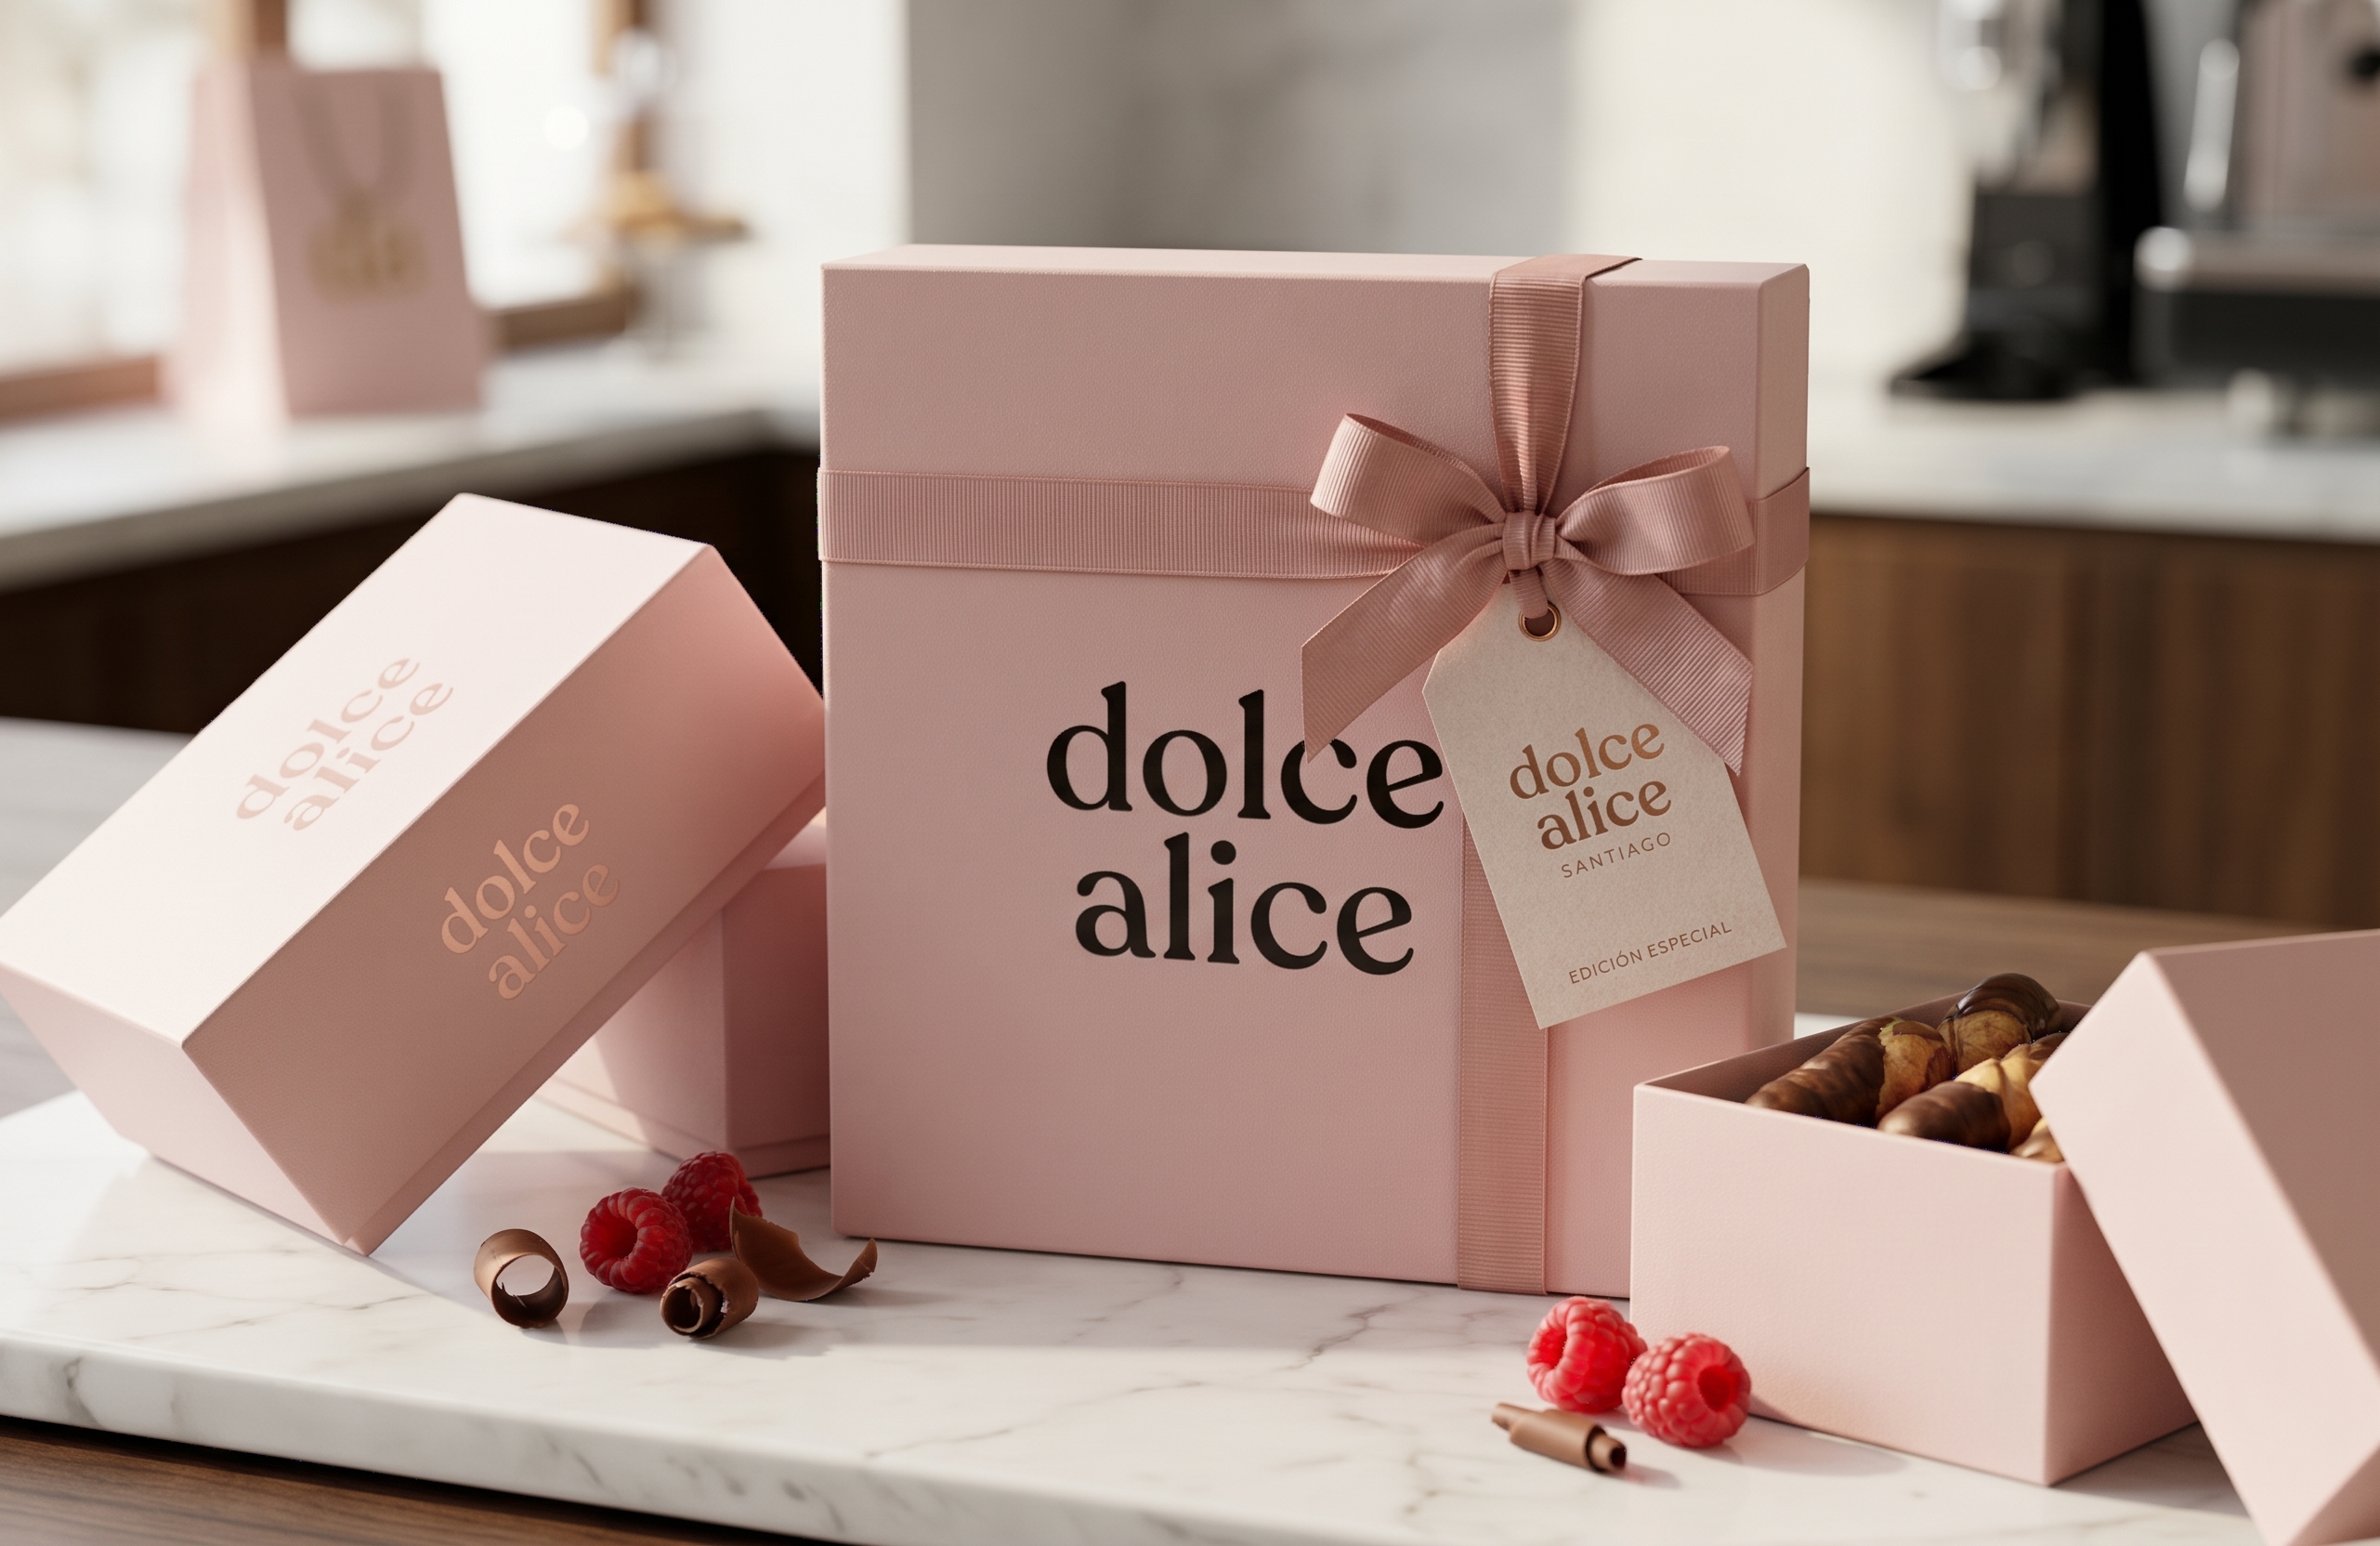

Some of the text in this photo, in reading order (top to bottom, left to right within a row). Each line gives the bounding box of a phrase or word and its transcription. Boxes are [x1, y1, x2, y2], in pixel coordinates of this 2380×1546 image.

[236, 658, 420, 819] dolce
[283, 683, 453, 831] alice
[1046, 681, 1445, 829] dolce
[1510, 723, 1665, 800] dolce
[441, 803, 590, 954] dolce
[1537, 780, 1672, 850] alice
[1561, 832, 1671, 878] SANTIAGO
[489, 864, 620, 1000] alice
[1075, 832, 1415, 976] alice
[1569, 922, 1733, 984] EDICIÓN ESPECIAL
